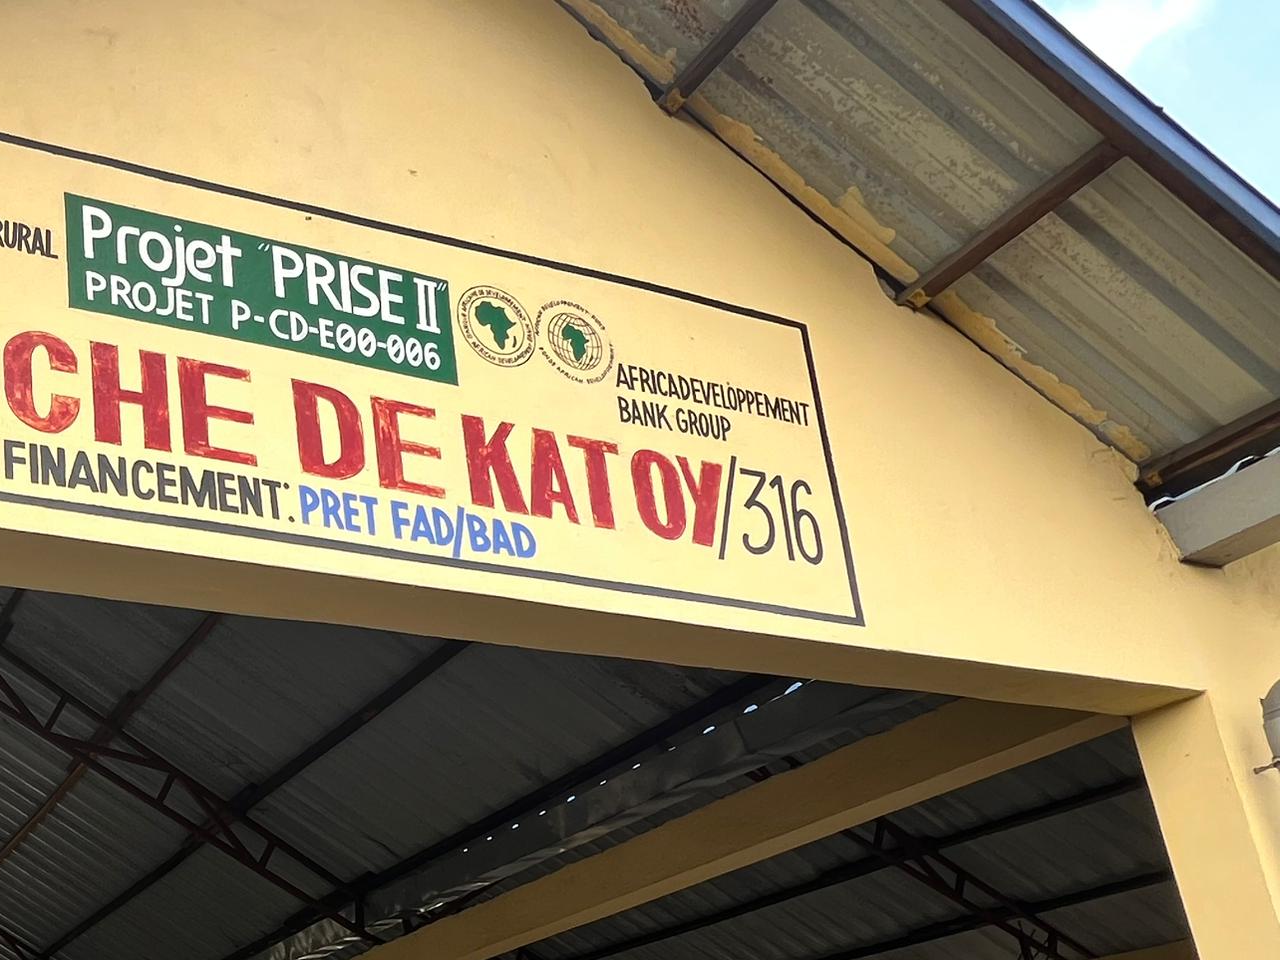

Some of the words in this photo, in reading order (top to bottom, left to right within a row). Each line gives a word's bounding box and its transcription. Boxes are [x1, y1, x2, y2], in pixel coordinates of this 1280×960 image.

[81, 204, 242, 287] Projet
[85, 270, 214, 325] PROJET
[616, 363, 810, 426] AFRICADEVELOPPEMENT
[617, 396, 673, 431] BANK
[676, 408, 731, 441] GROUP
[291, 378, 446, 499] DE
[298, 484, 377, 536] PRET
[391, 499, 537, 559] FAD/BAD
